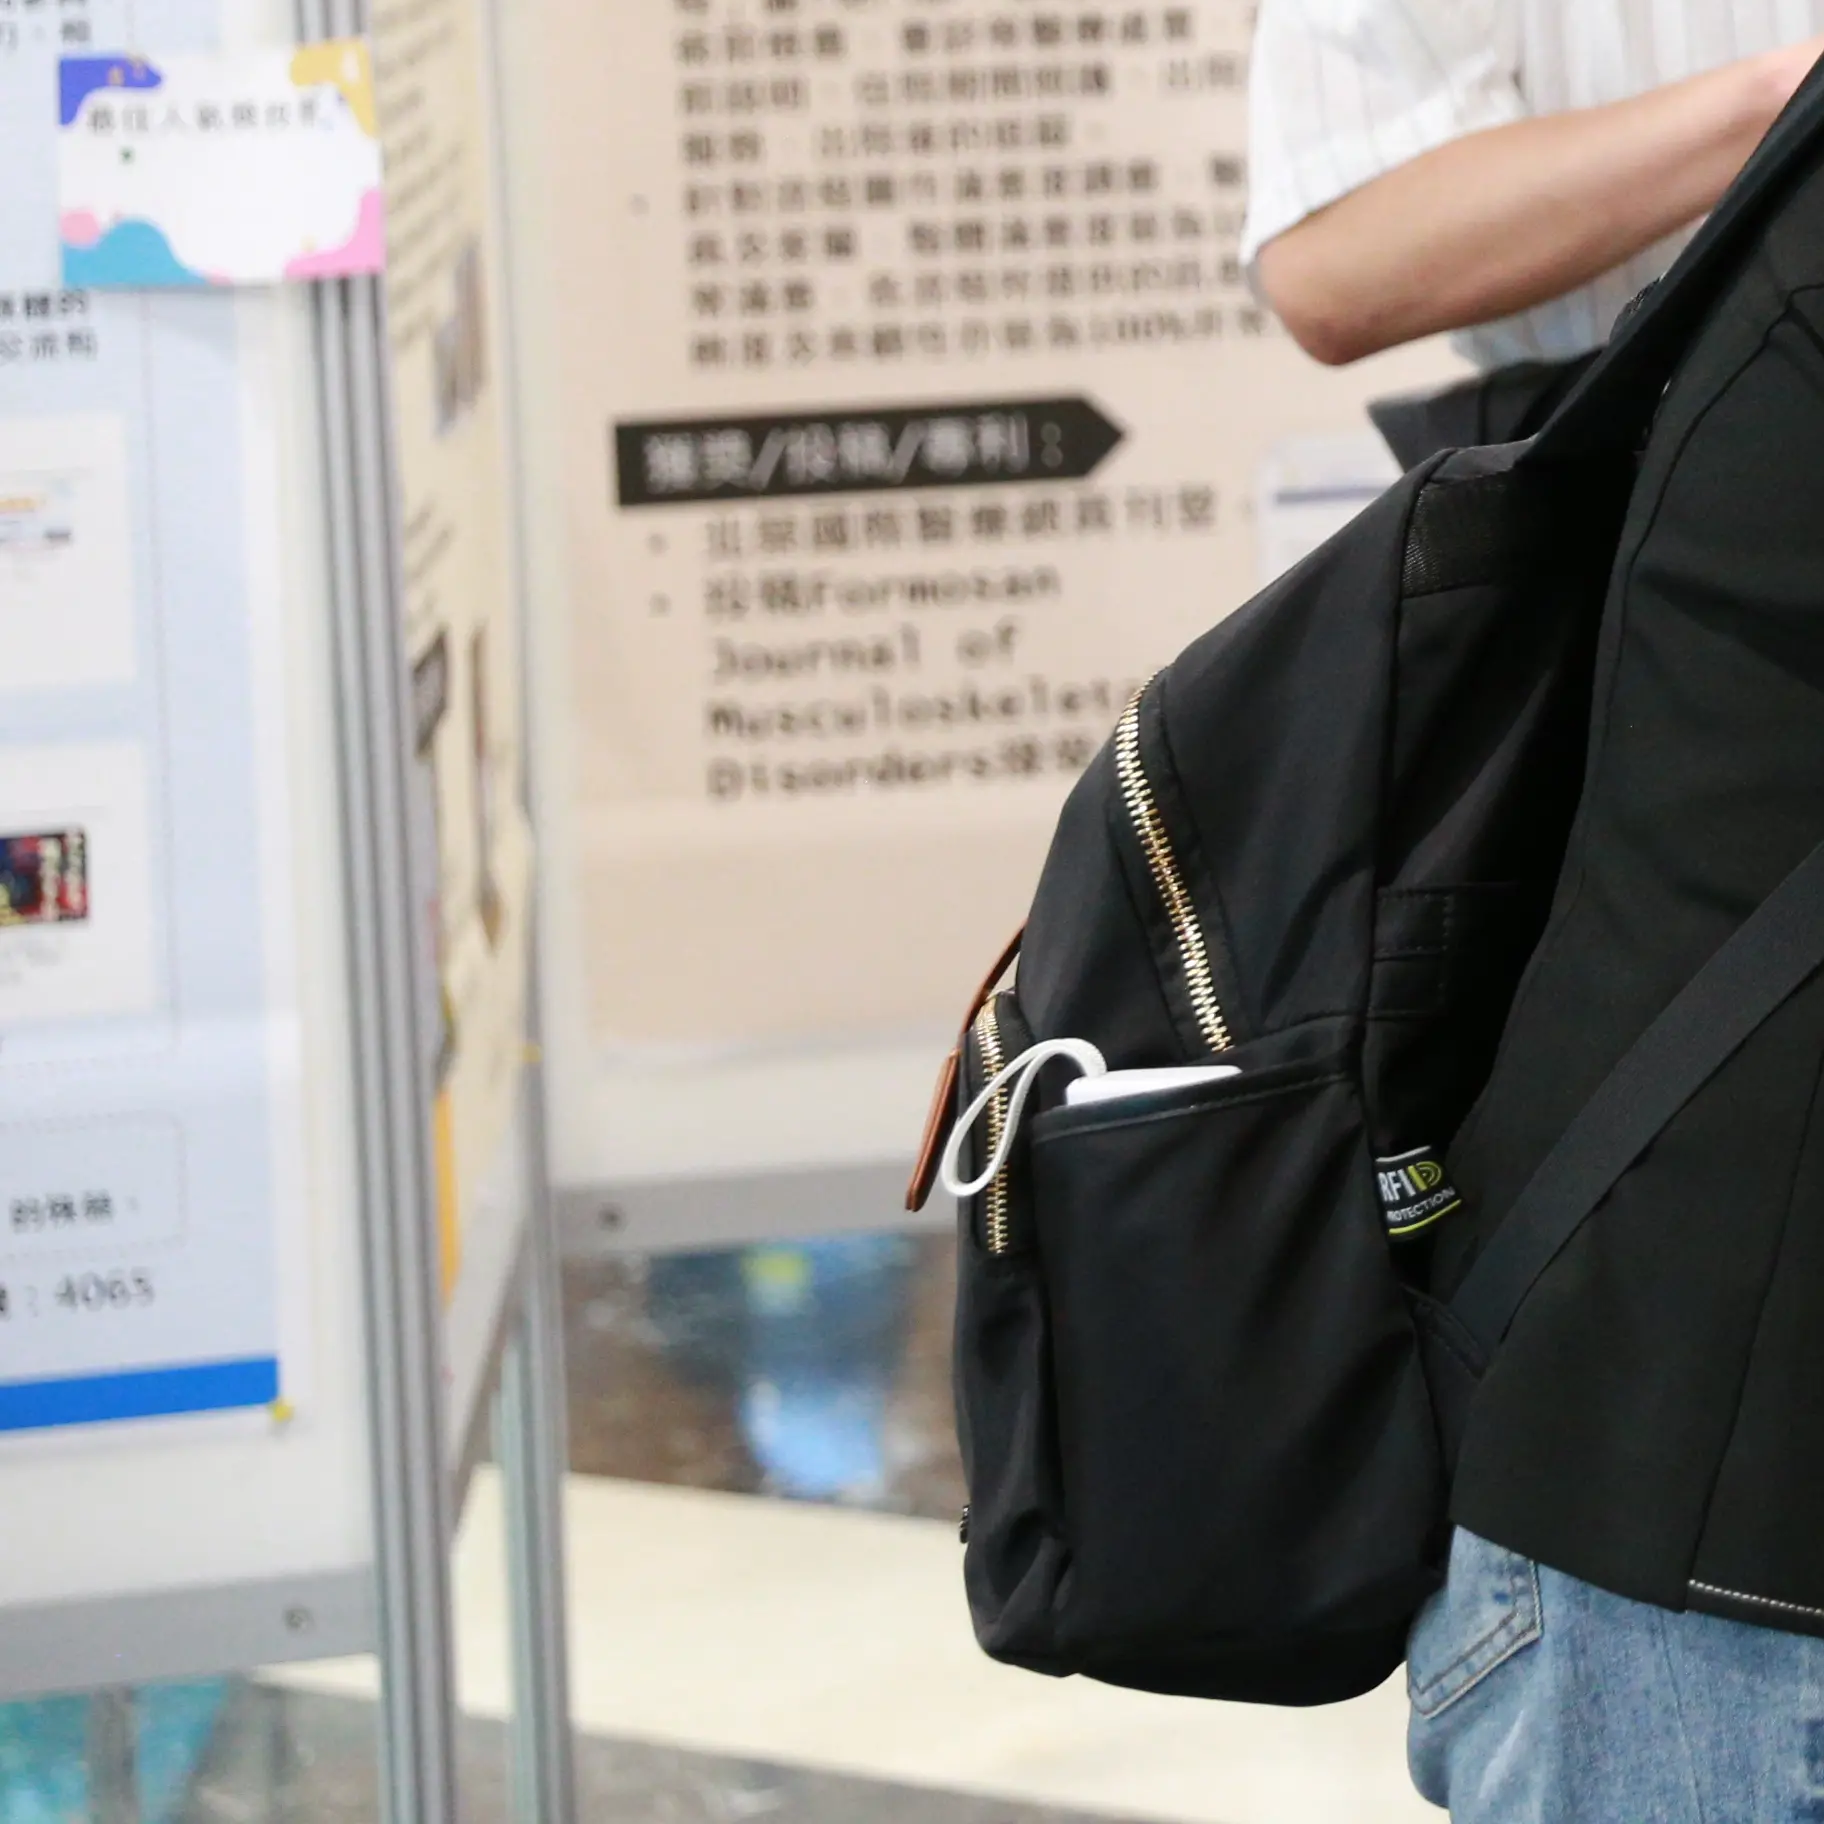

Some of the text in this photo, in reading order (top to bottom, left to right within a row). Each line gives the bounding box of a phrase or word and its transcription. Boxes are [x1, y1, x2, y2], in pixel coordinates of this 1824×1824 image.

[712, 621, 1020, 678] Journal of
[1378, 1161, 1442, 1201] RFID
